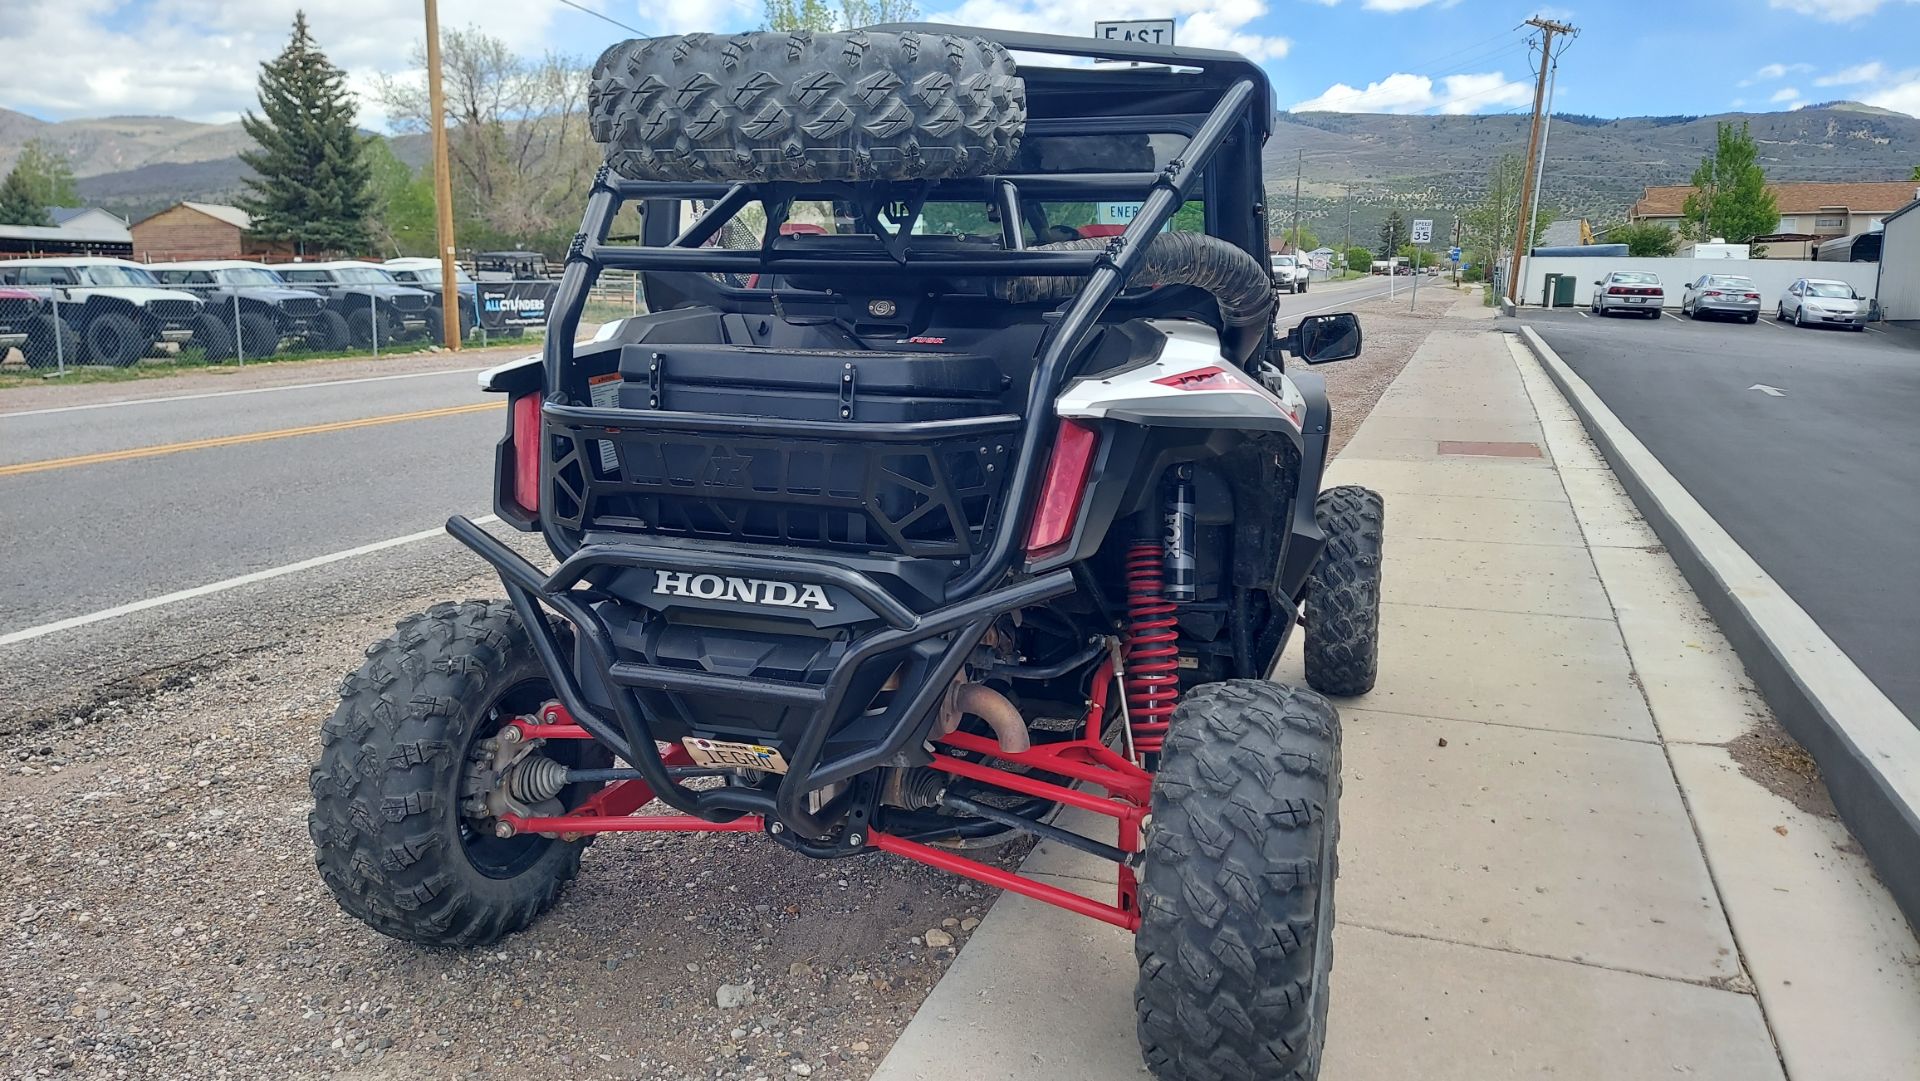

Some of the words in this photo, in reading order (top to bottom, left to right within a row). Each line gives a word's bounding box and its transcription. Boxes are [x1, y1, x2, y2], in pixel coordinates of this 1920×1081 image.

[1105, 27, 1164, 44] EAST
[1413, 231, 1430, 241] 35
[1164, 511, 1181, 559] FOX
[652, 570, 835, 611] HONDA
